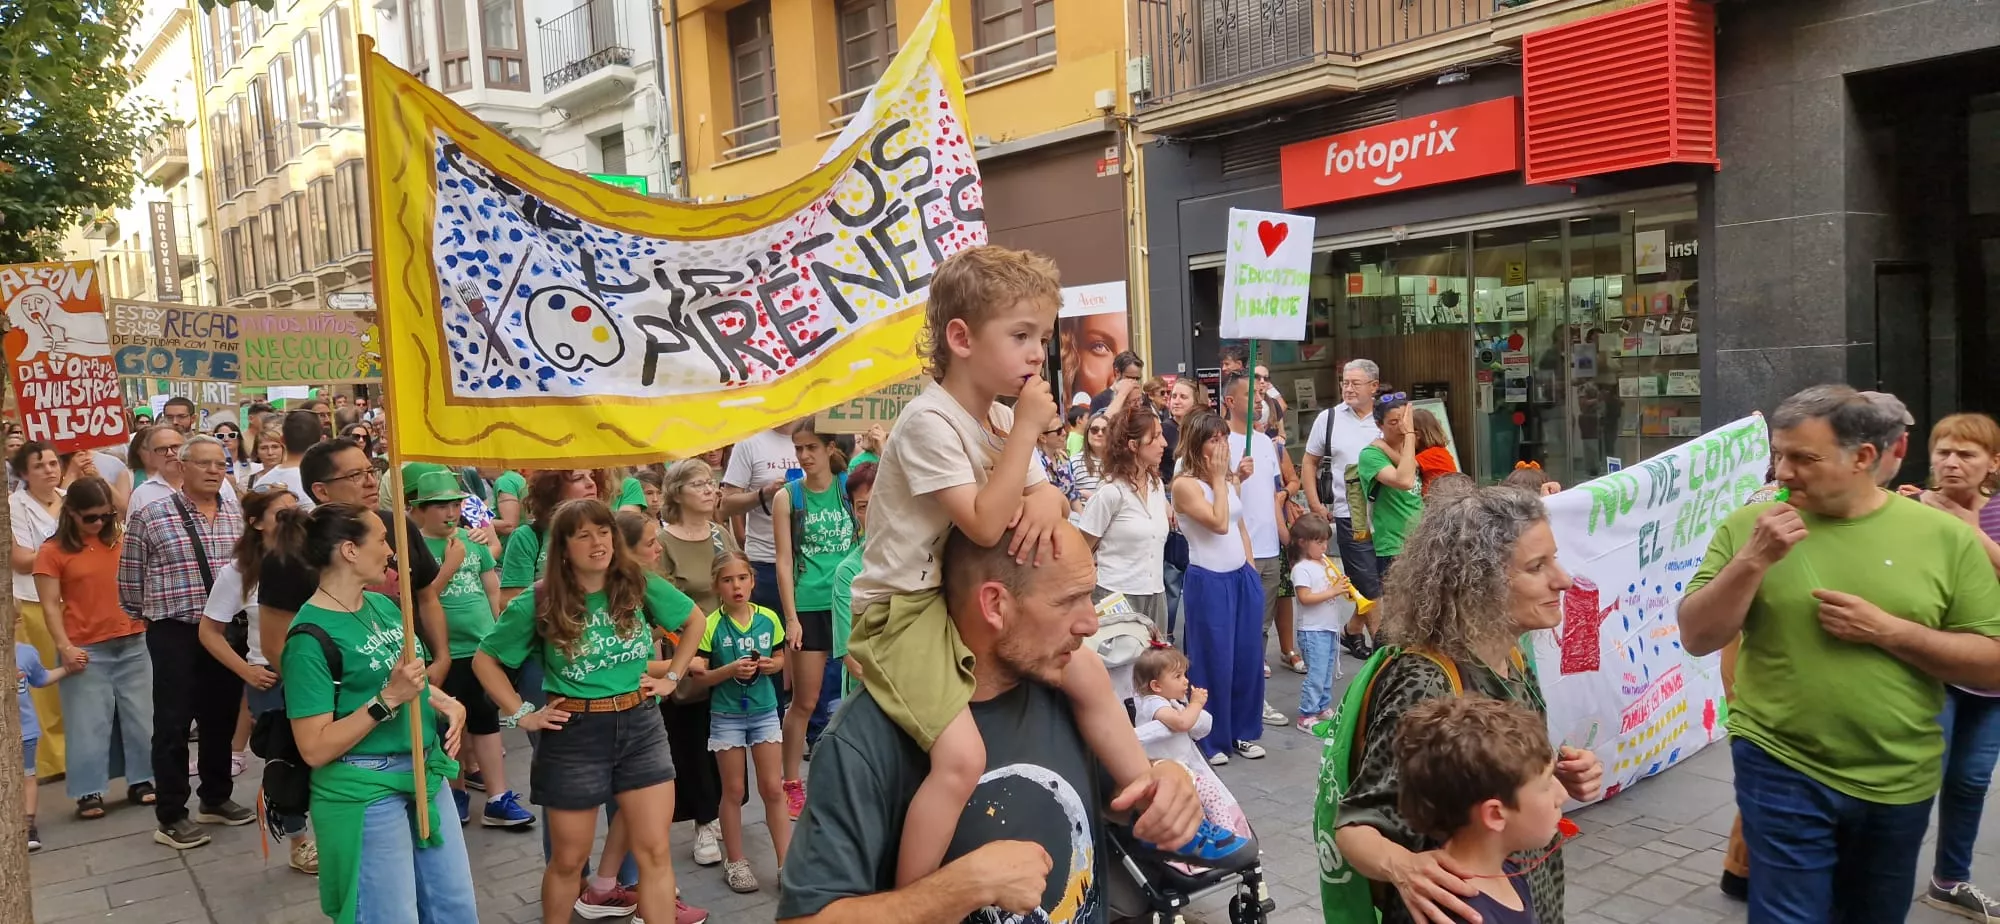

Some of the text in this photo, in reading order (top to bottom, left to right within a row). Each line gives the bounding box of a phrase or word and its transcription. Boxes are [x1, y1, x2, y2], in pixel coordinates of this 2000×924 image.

[1325, 120, 1458, 176] fotoprix
[112, 335, 129, 345] DE
[115, 345, 241, 380] GOTE
[25, 405, 124, 442] HIJOS
[1579, 473, 1639, 537] NO
[1644, 454, 1682, 510] ME
[1639, 520, 1664, 571] EL
[737, 637, 755, 651] 19
